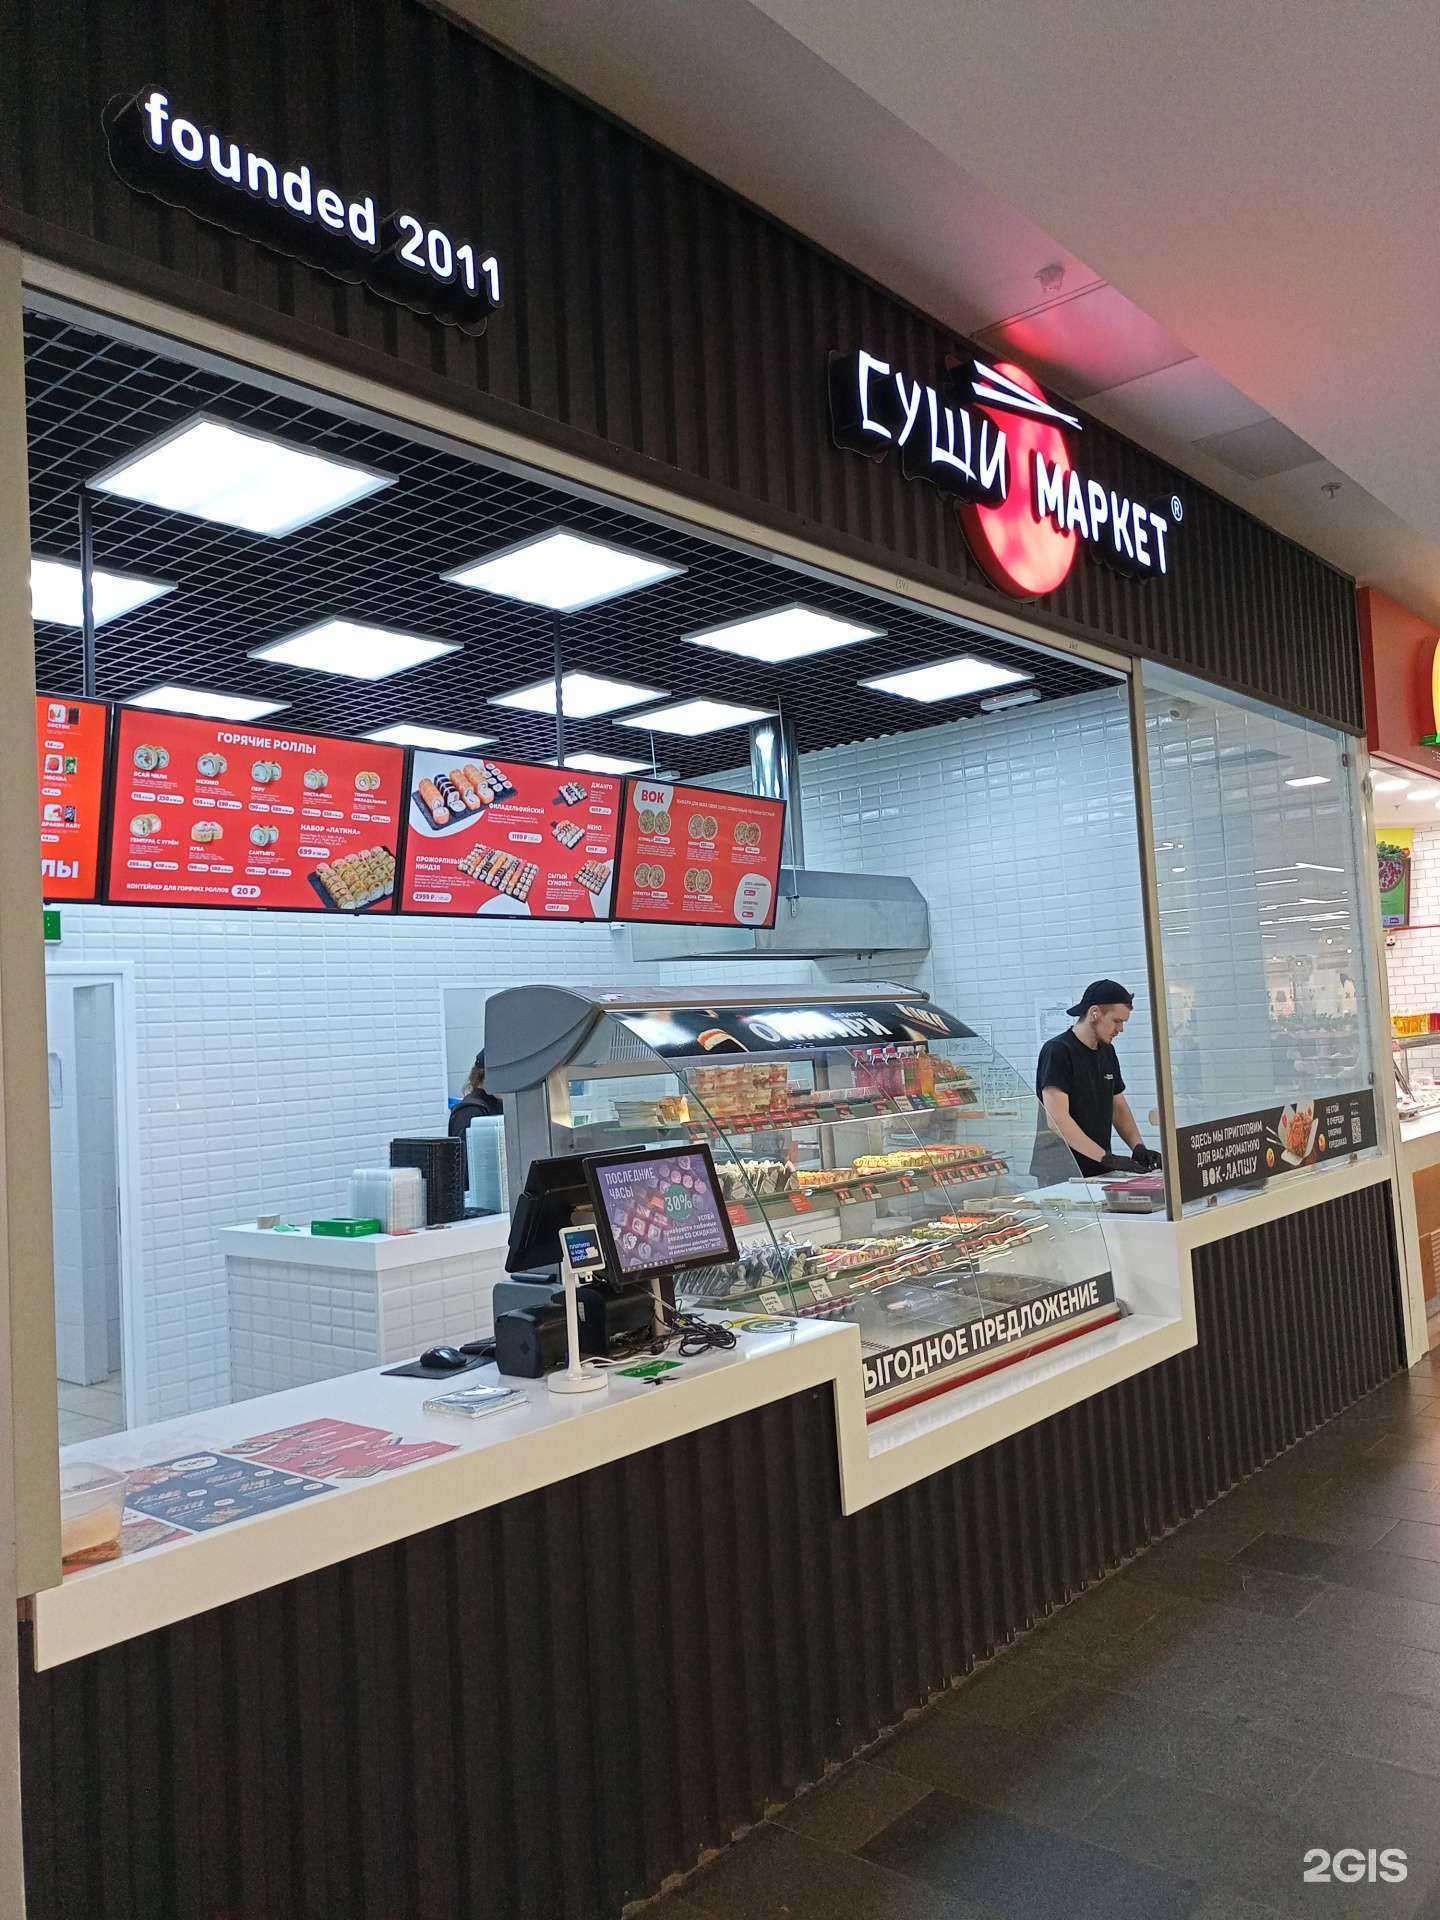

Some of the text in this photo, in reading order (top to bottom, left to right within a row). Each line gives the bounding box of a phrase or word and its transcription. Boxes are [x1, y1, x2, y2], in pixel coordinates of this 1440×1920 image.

[144, 92, 501, 302] founded 2011
[858, 349, 1008, 501] СУШИ
[1035, 450, 1168, 574] МАРКЕТ
[217, 731, 317, 755] ГОРЯЧИЕ РОЛЛЫ
[641, 789, 665, 804] ВОК
[300, 824, 325, 832] НАБОР
[415, 863, 441, 872] НИНДЗЯ
[236, 887, 248, 895] 20
[1190, 1121, 1263, 1149] ЗДЕСЬ МЫ ПРИГОТОВИМ
[1197, 1138, 1260, 1168] ДЛЯ ВАС АРОМАТНУЮ
[604, 1167, 656, 1185] ПОСЛЕДНИЕ
[608, 1186, 634, 1200] ЧАСЫ
[664, 1193, 693, 1212] 30%
[971, 1280, 1100, 1350] ПРЕДЛОЖЕНИЕ
